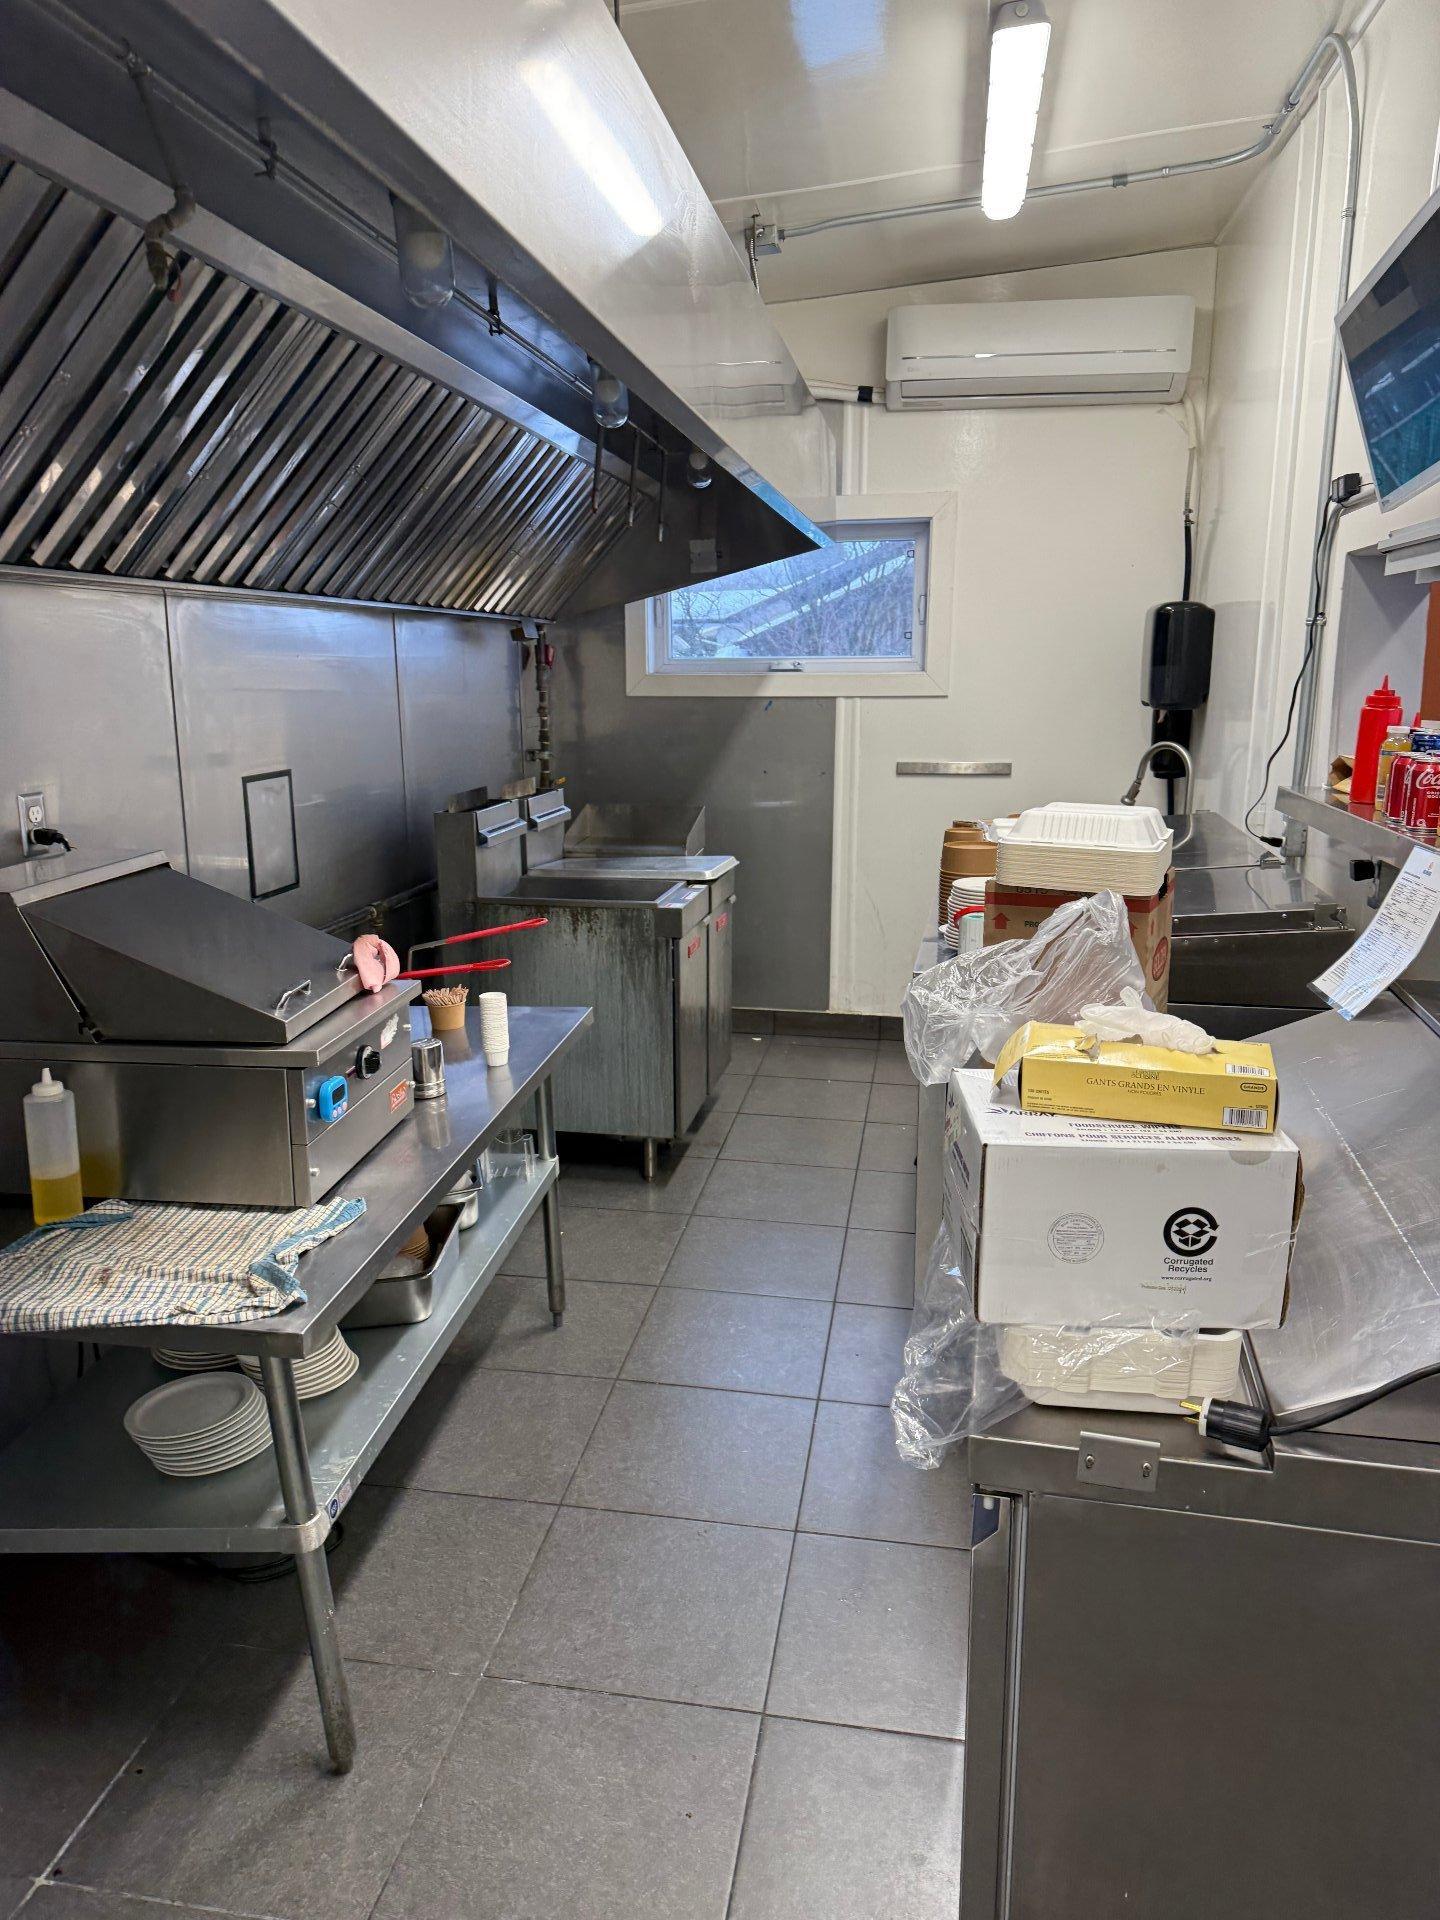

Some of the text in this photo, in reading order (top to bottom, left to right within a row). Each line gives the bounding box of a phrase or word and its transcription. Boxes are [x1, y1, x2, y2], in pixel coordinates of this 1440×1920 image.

[1086, 1077, 1206, 1095] GANTS GRANDS EN VINYLE
[1068, 1122, 1137, 1130] FOODSERVICE
[1110, 1133, 1162, 1141] SERVICES
[1163, 1256, 1214, 1266] Corrugated
[1168, 1264, 1208, 1274] Recycles
